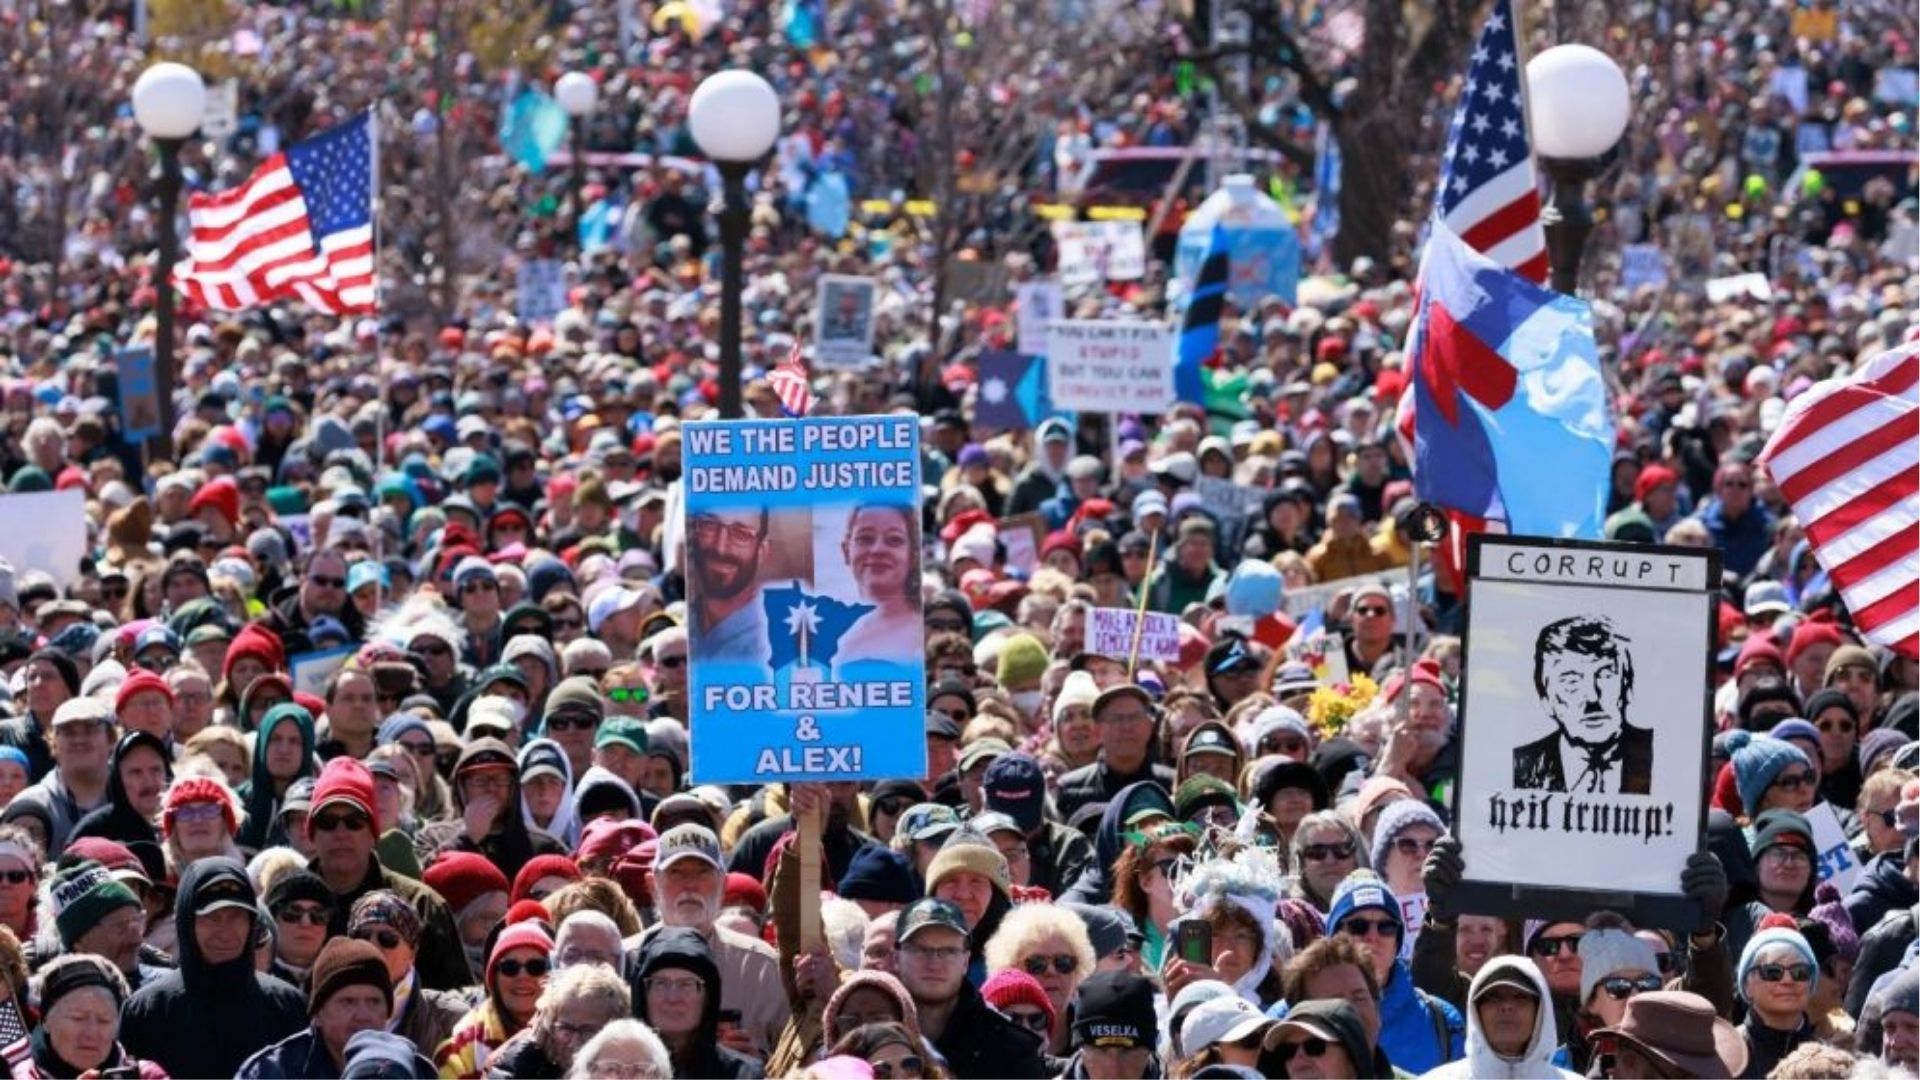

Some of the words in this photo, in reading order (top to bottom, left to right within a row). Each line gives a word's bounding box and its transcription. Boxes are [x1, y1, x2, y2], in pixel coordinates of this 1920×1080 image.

[1059, 363, 1084, 377] BUT
[1091, 364, 1122, 379] YOU
[1128, 366, 1161, 380] CAN
[690, 429, 731, 454] WE
[740, 427, 794, 452] THE
[803, 423, 911, 450] PEOPLE
[691, 465, 797, 492] DEMAND
[804, 462, 911, 488] JUSTICE
[1507, 552, 1681, 583] CORRUPT
[705, 685, 777, 711] FOR
[790, 682, 912, 709] RENEE
[795, 714, 821, 741] &
[756, 747, 862, 774] ALEX!
[1563, 796, 1674, 845] trump!
[1090, 1024, 1139, 1037] VESELKA
